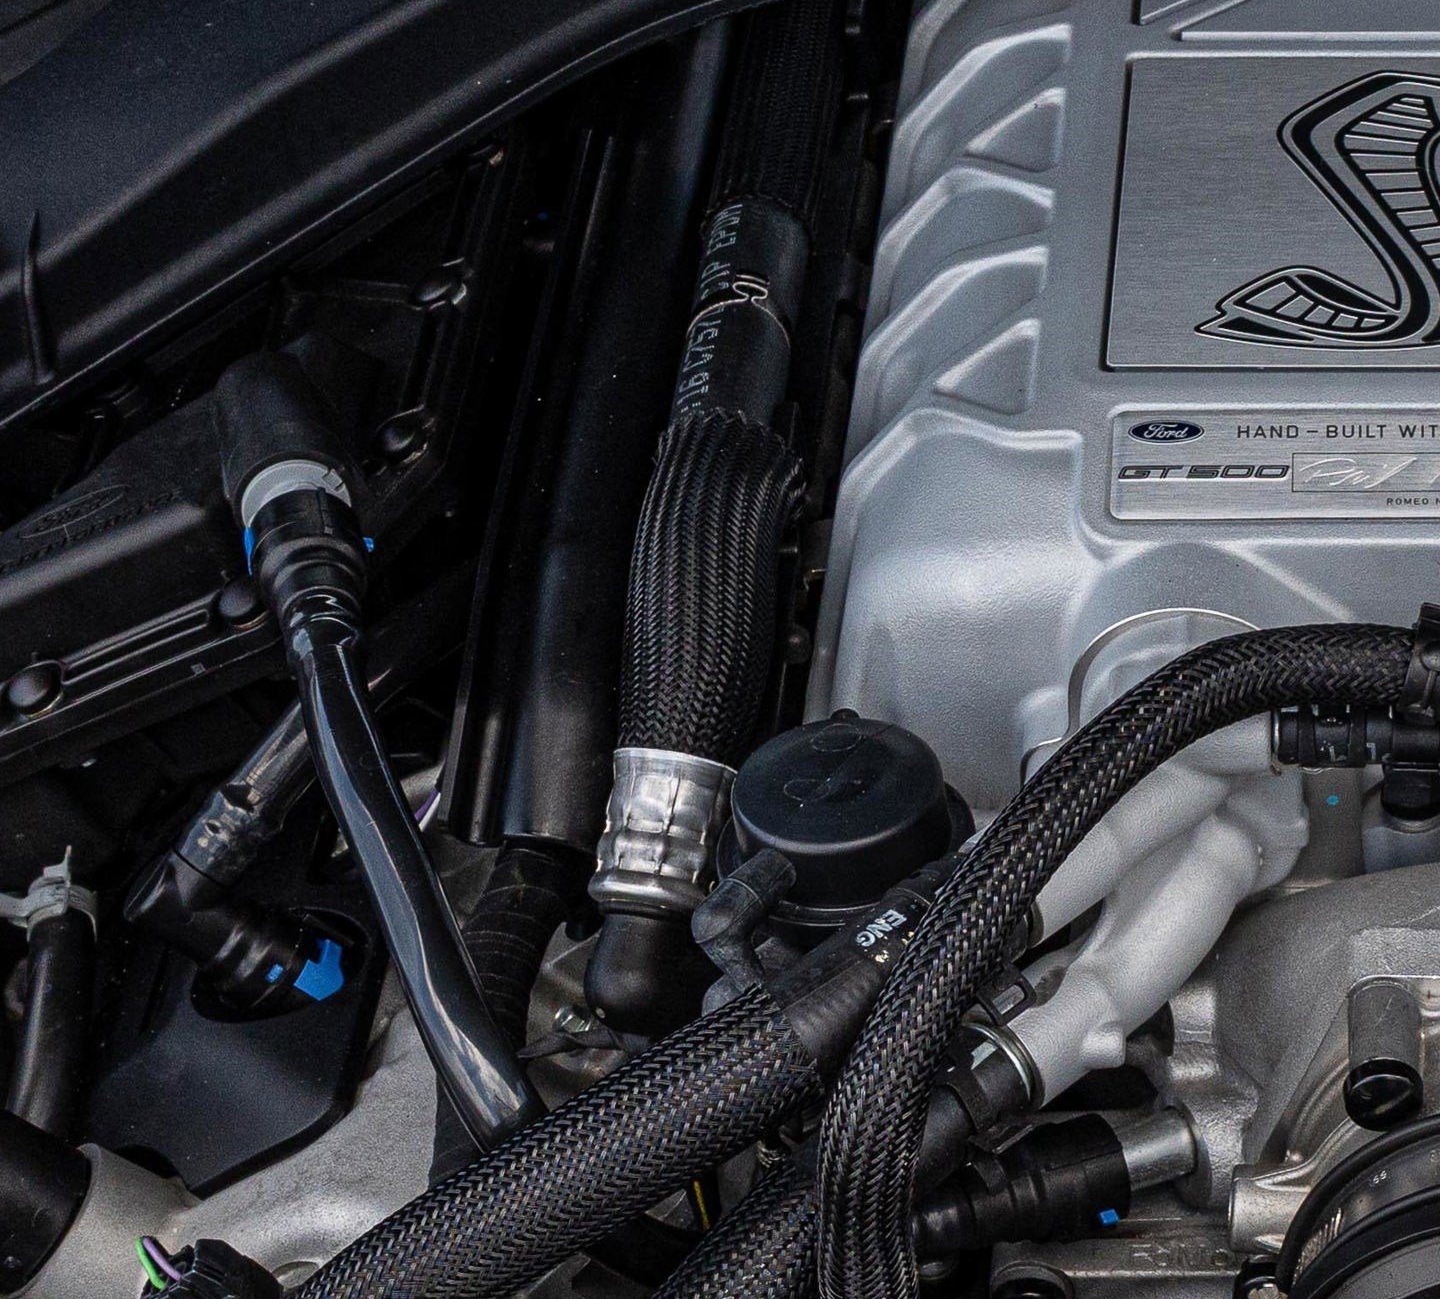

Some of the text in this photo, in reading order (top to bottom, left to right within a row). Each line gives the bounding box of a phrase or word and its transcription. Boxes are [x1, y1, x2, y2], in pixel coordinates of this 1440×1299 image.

[1143, 422, 1190, 442] Ford
[1237, 424, 1299, 440] HAND
[1326, 424, 1388, 440] BUILT
[1387, 497, 1429, 506] ROMEO
